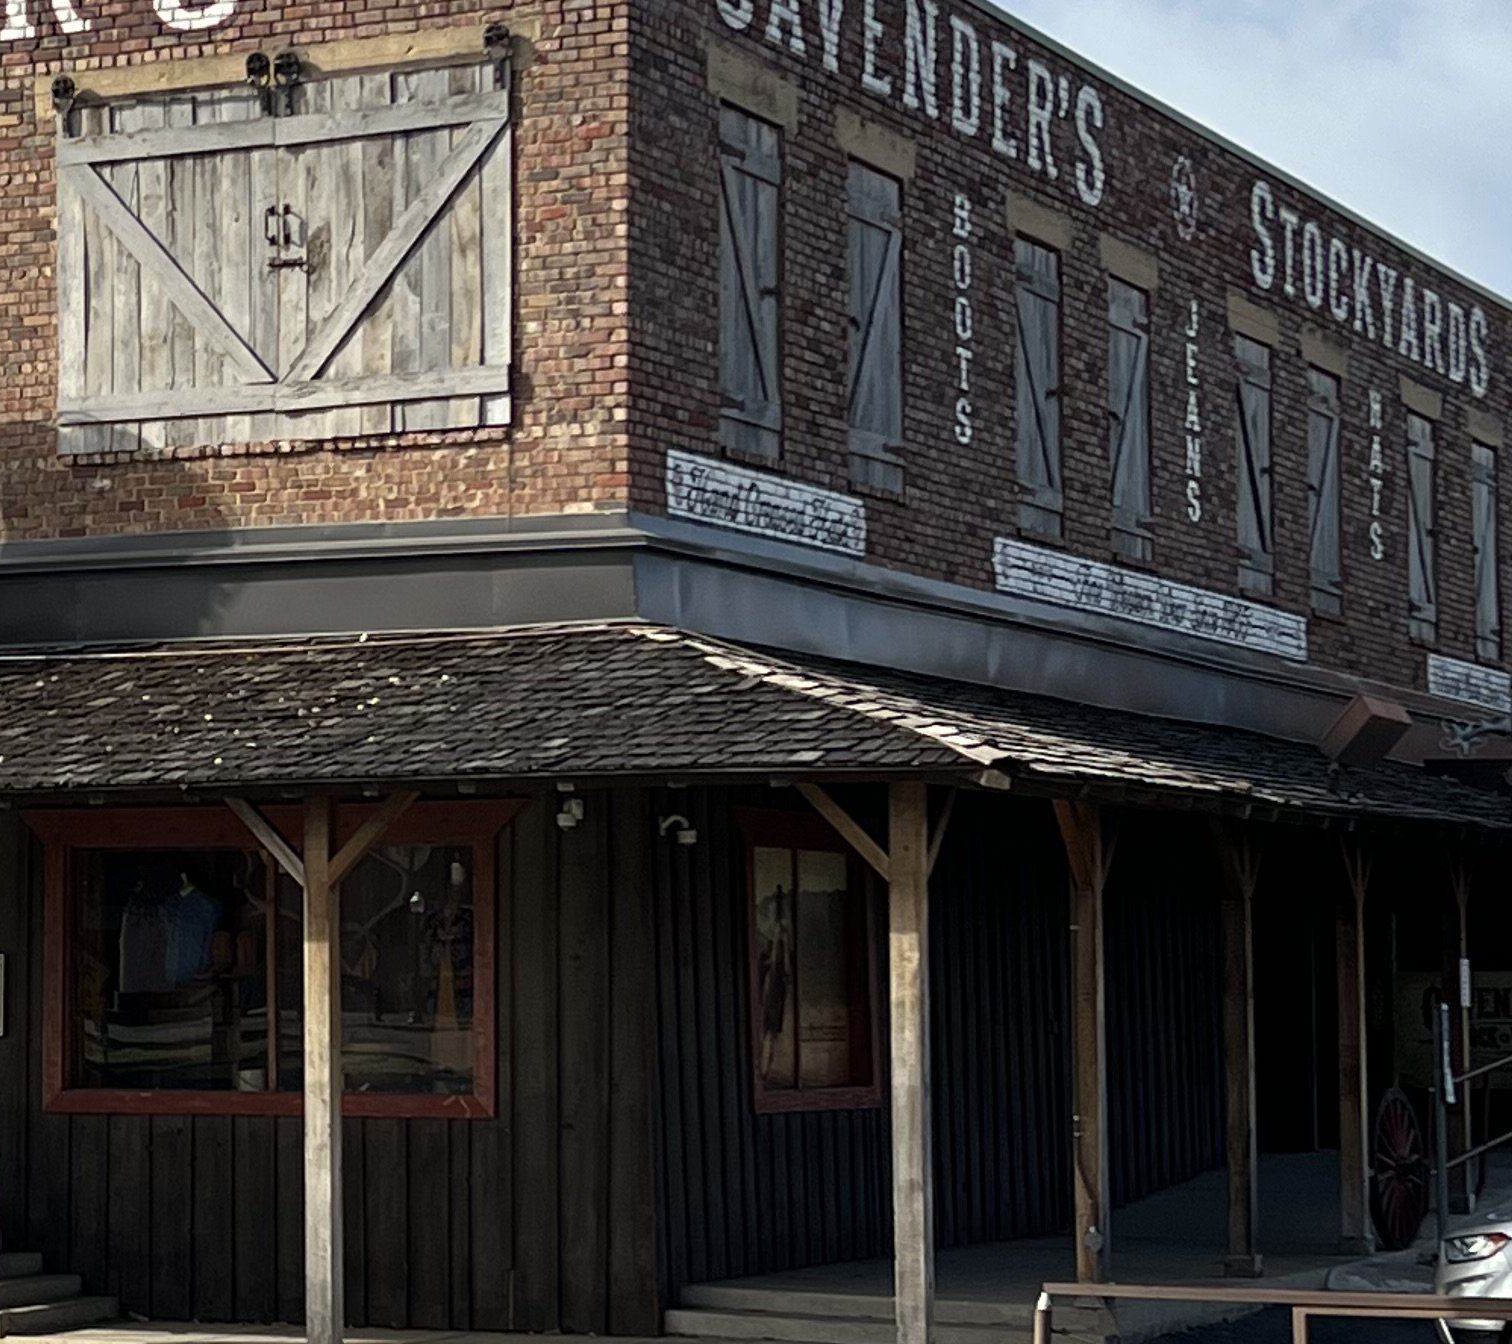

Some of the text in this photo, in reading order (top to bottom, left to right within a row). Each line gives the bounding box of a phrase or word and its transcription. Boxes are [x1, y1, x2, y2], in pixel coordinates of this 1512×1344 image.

[952, 193, 973, 446] BOOTS
[1251, 180, 1488, 398] STOCKYARDS
[1185, 299, 1201, 523] JEANS
[1368, 389, 1384, 560] HATS
